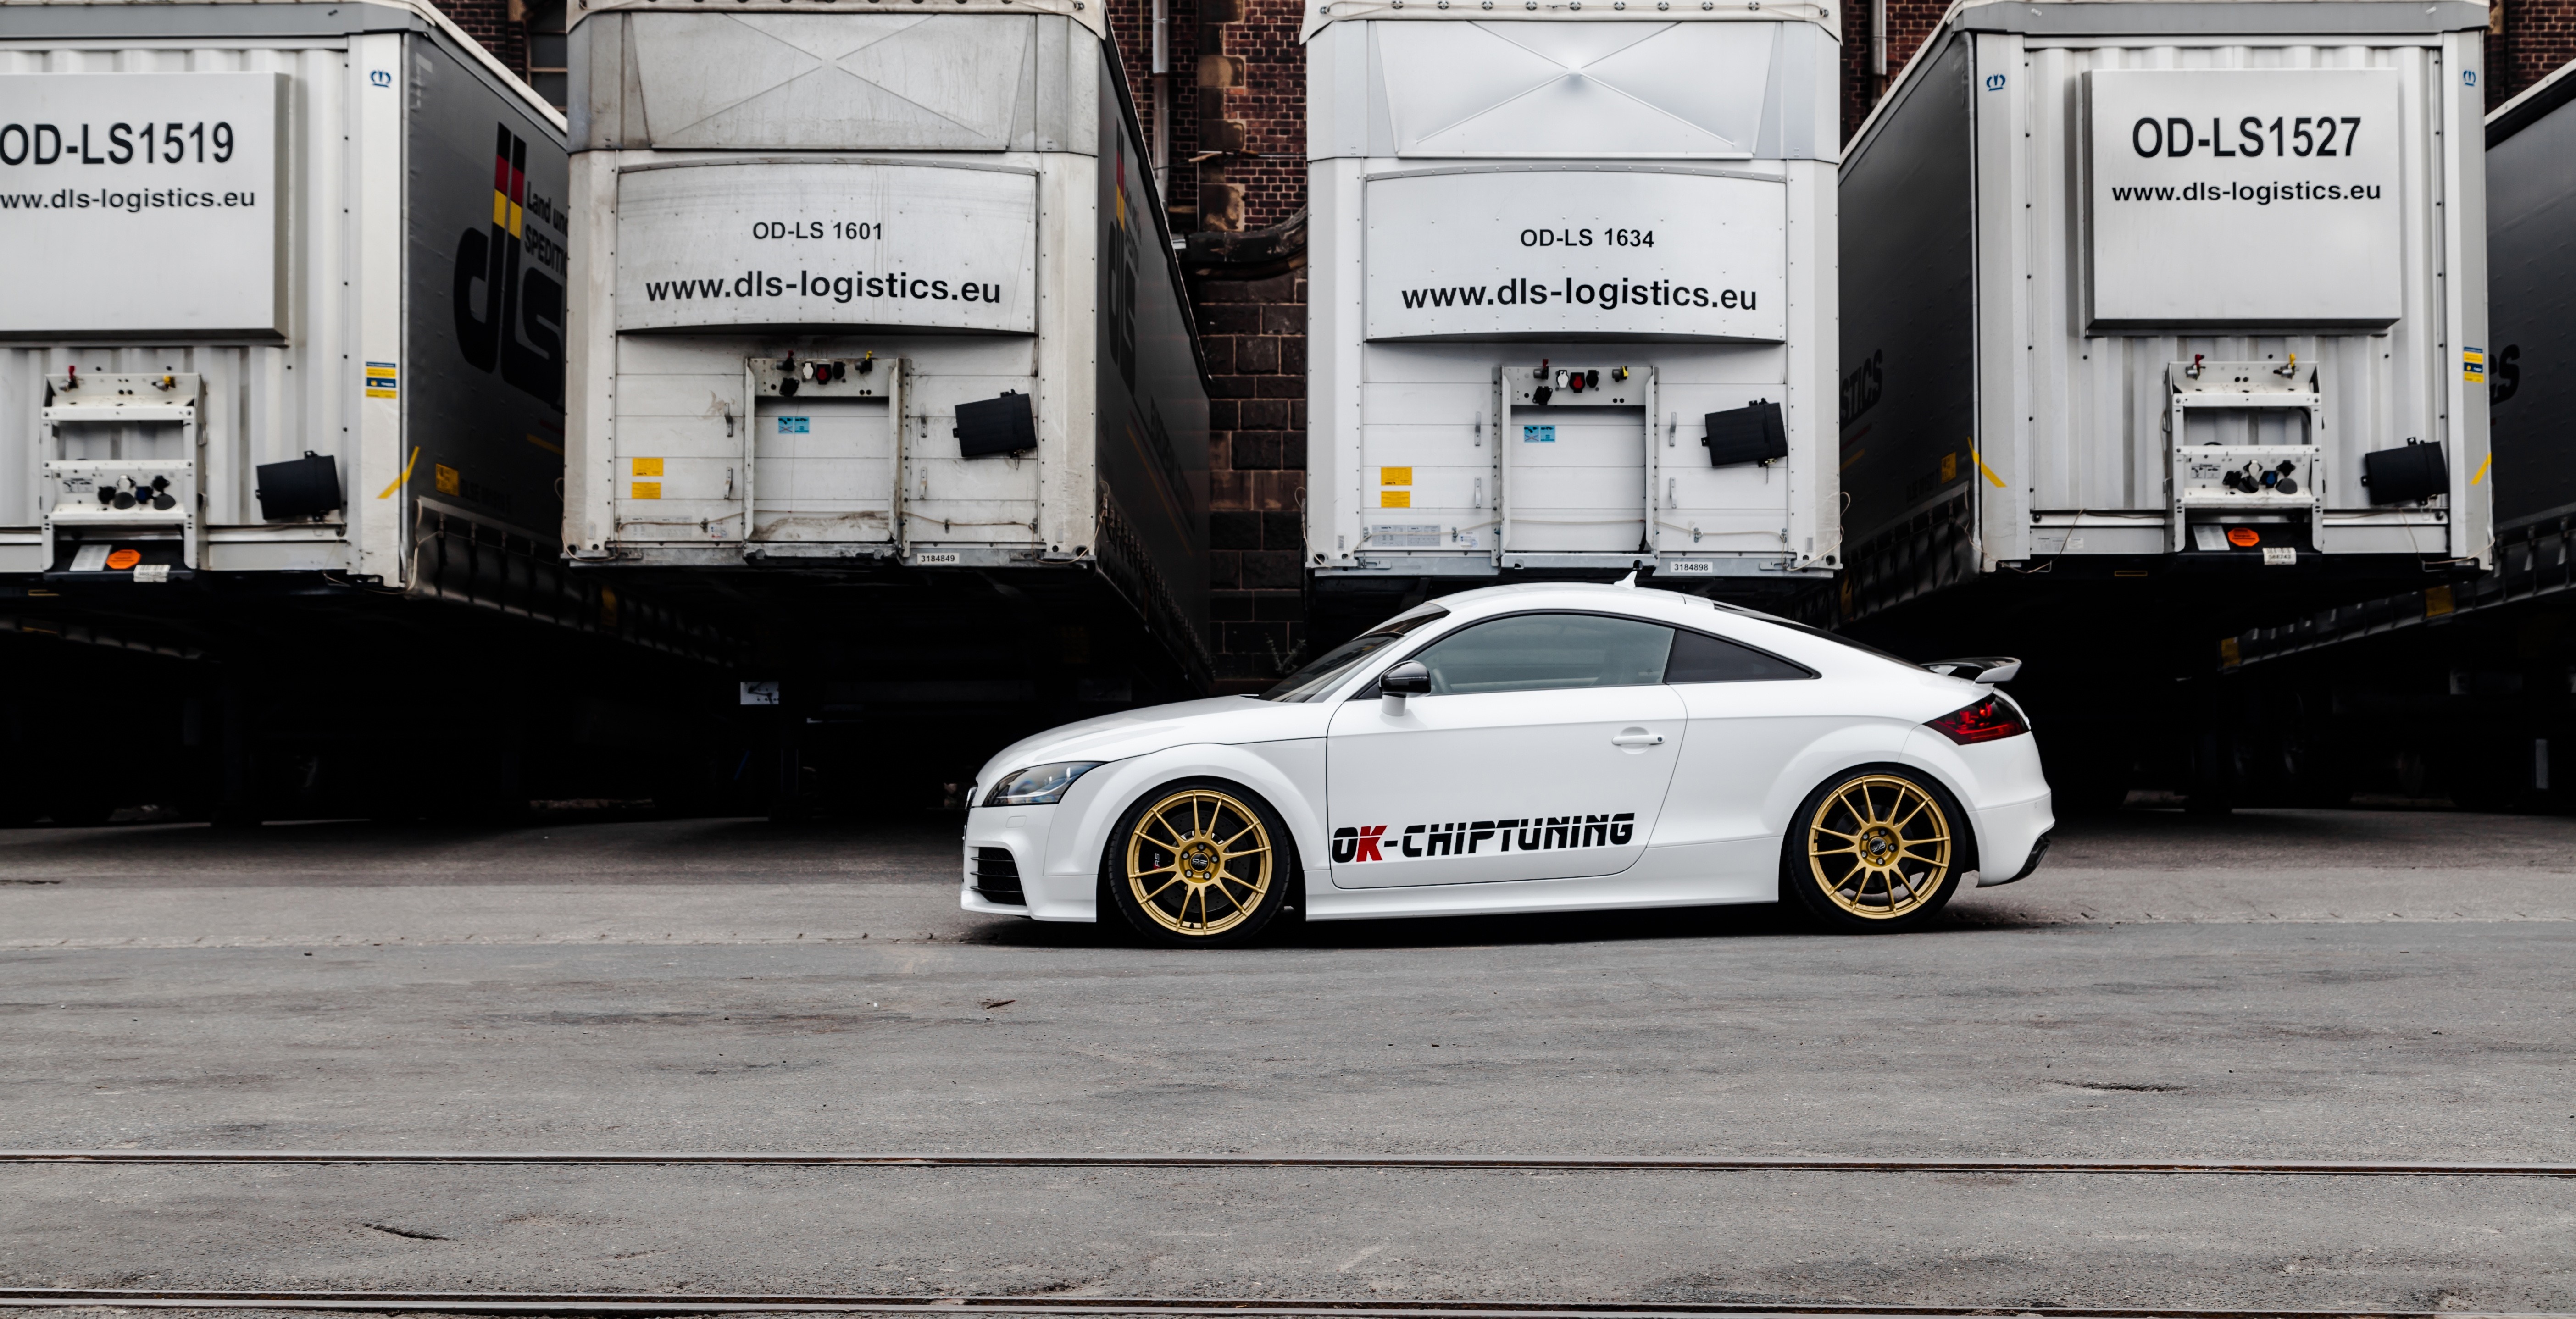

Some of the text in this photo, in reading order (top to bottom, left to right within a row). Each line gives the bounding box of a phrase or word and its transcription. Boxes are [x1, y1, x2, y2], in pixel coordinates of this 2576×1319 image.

[0, 122, 233, 166] OD-LS1519
[2132, 116, 2361, 158] OD-LS1527
[527, 181, 551, 224] Land
[2112, 182, 2380, 205] www.dls-logistics.eu
[753, 222, 882, 240] OD-LS 1601
[1521, 228, 1654, 247] OD-LS 1634
[646, 270, 1000, 304] www.dls-logistics.eu
[1401, 277, 1756, 310] www.dls-logistics.eu
[1332, 813, 1635, 863] OK-CHIPTUNING
[1155, 853, 1160, 867] RS
